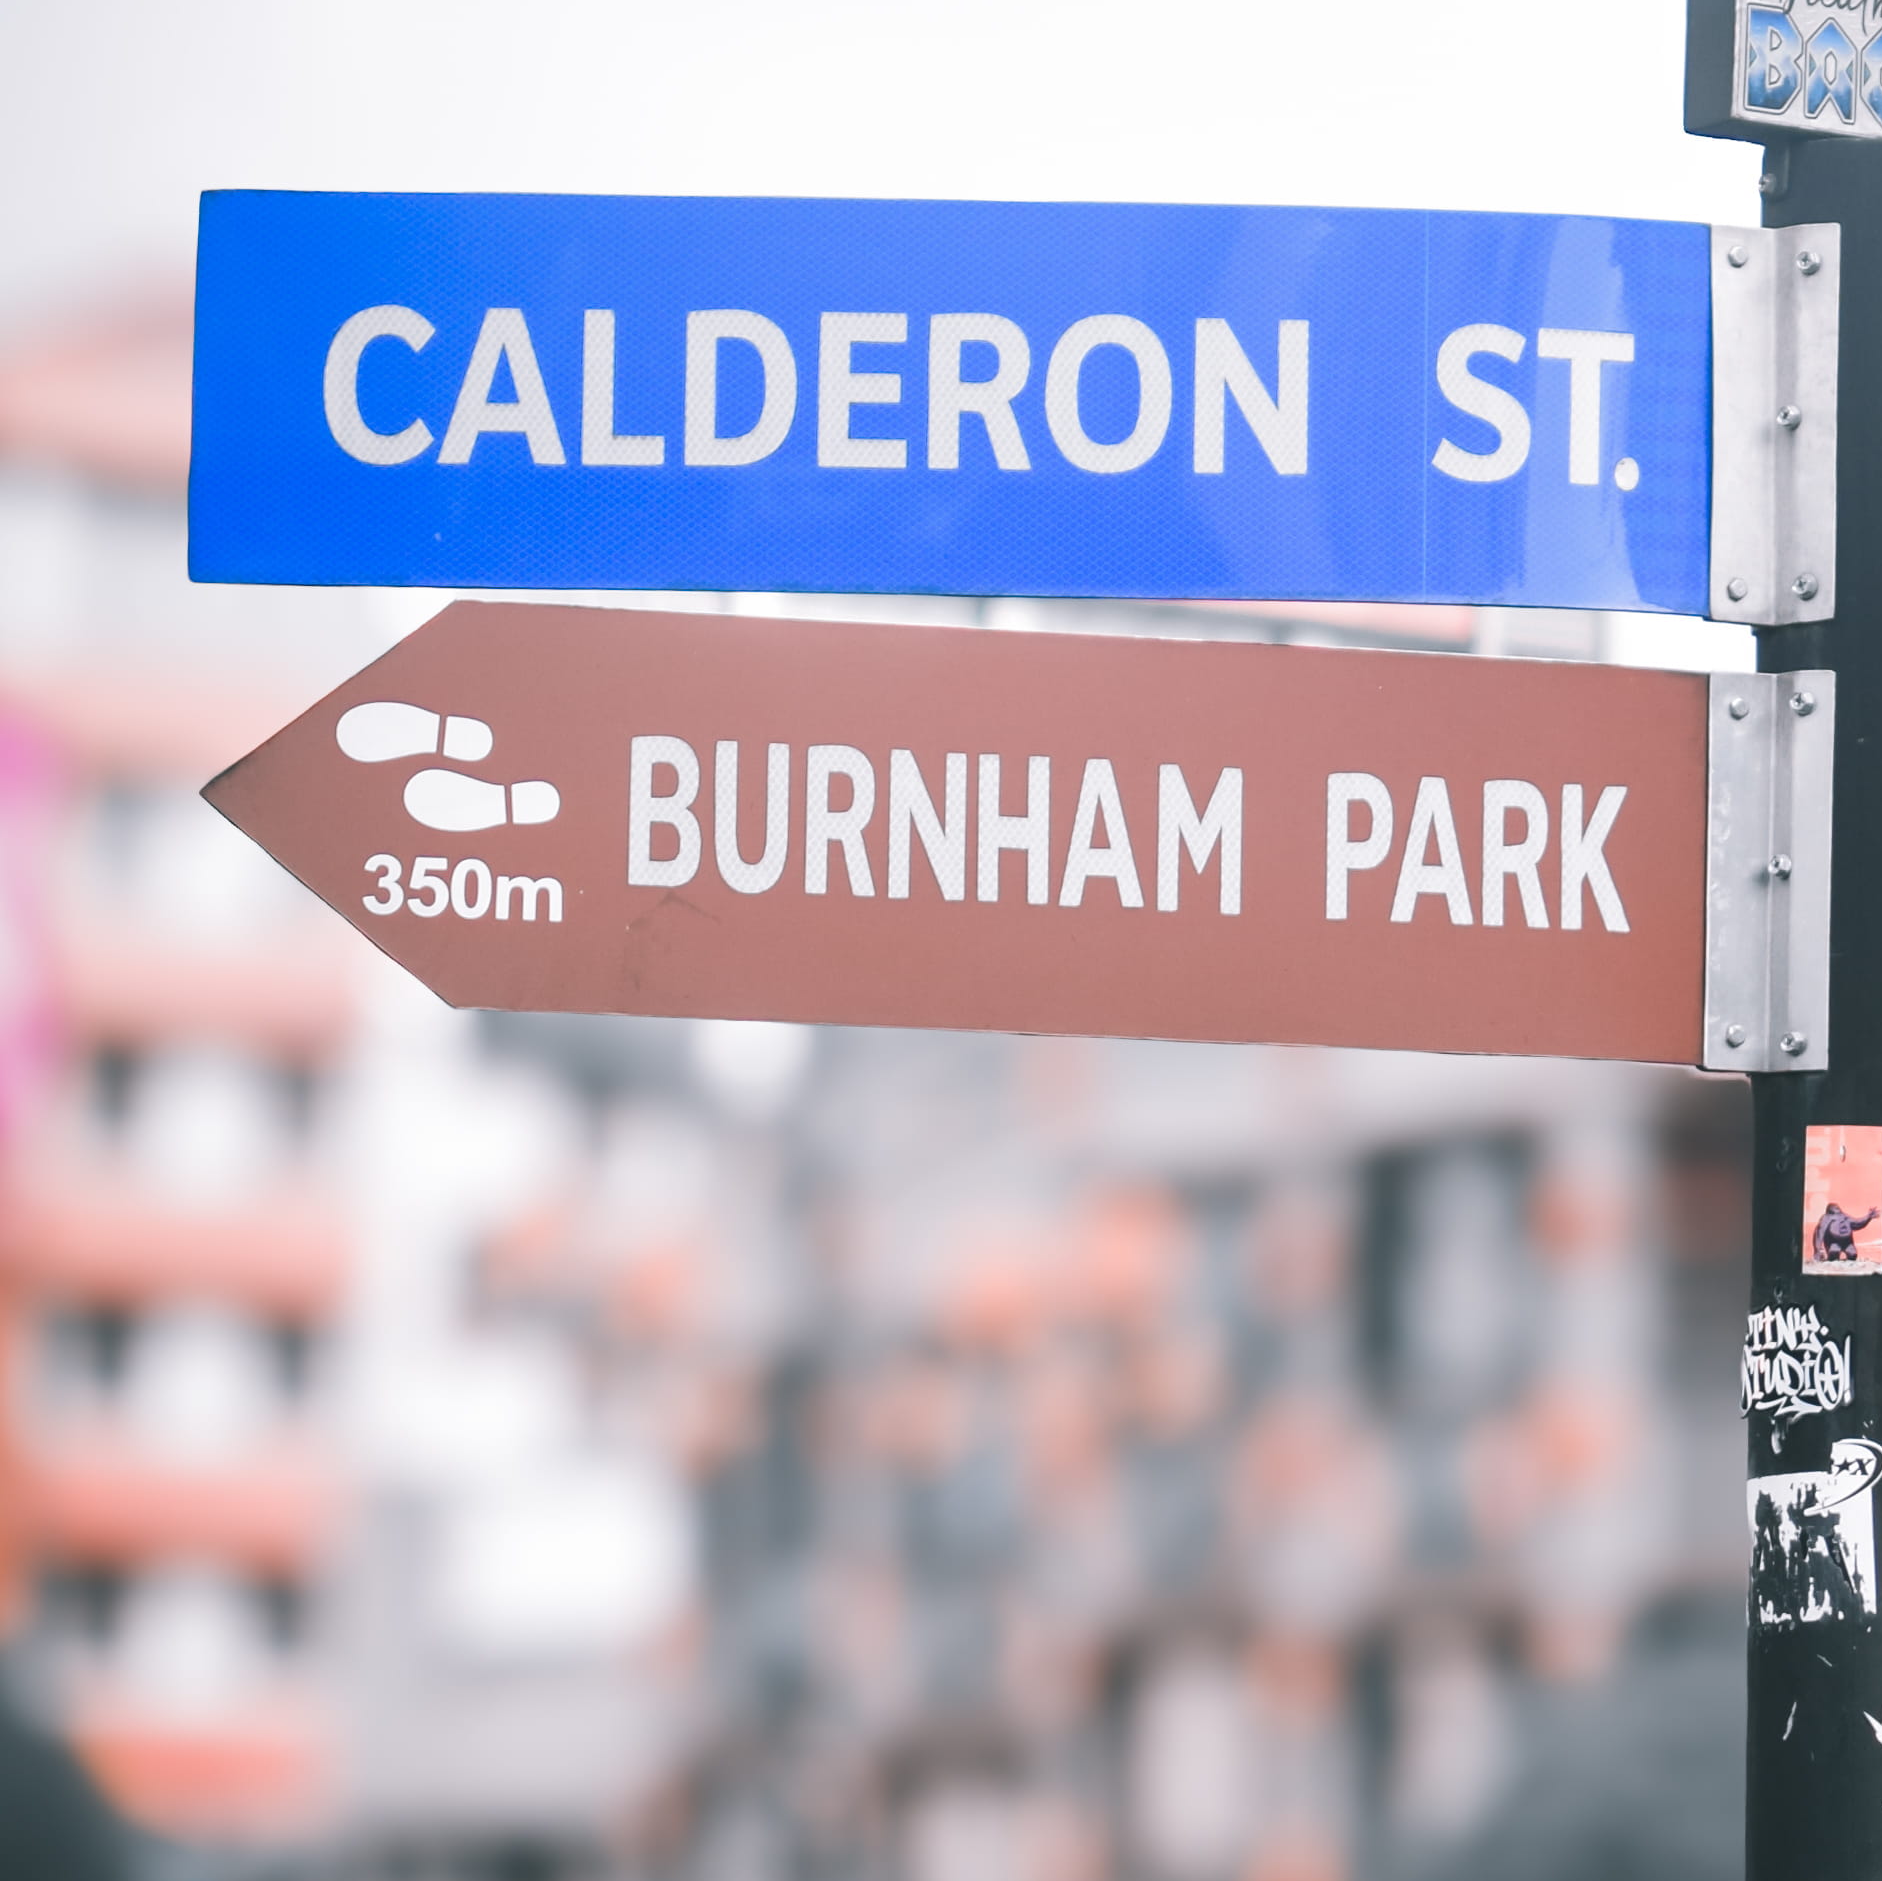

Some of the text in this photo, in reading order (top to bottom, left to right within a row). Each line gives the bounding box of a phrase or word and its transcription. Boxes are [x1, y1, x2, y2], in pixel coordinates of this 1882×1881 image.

[324, 304, 1641, 491] CALDERON ST.
[361, 853, 563, 923] 350m
[627, 735, 1631, 933] BURNHAM PARK
